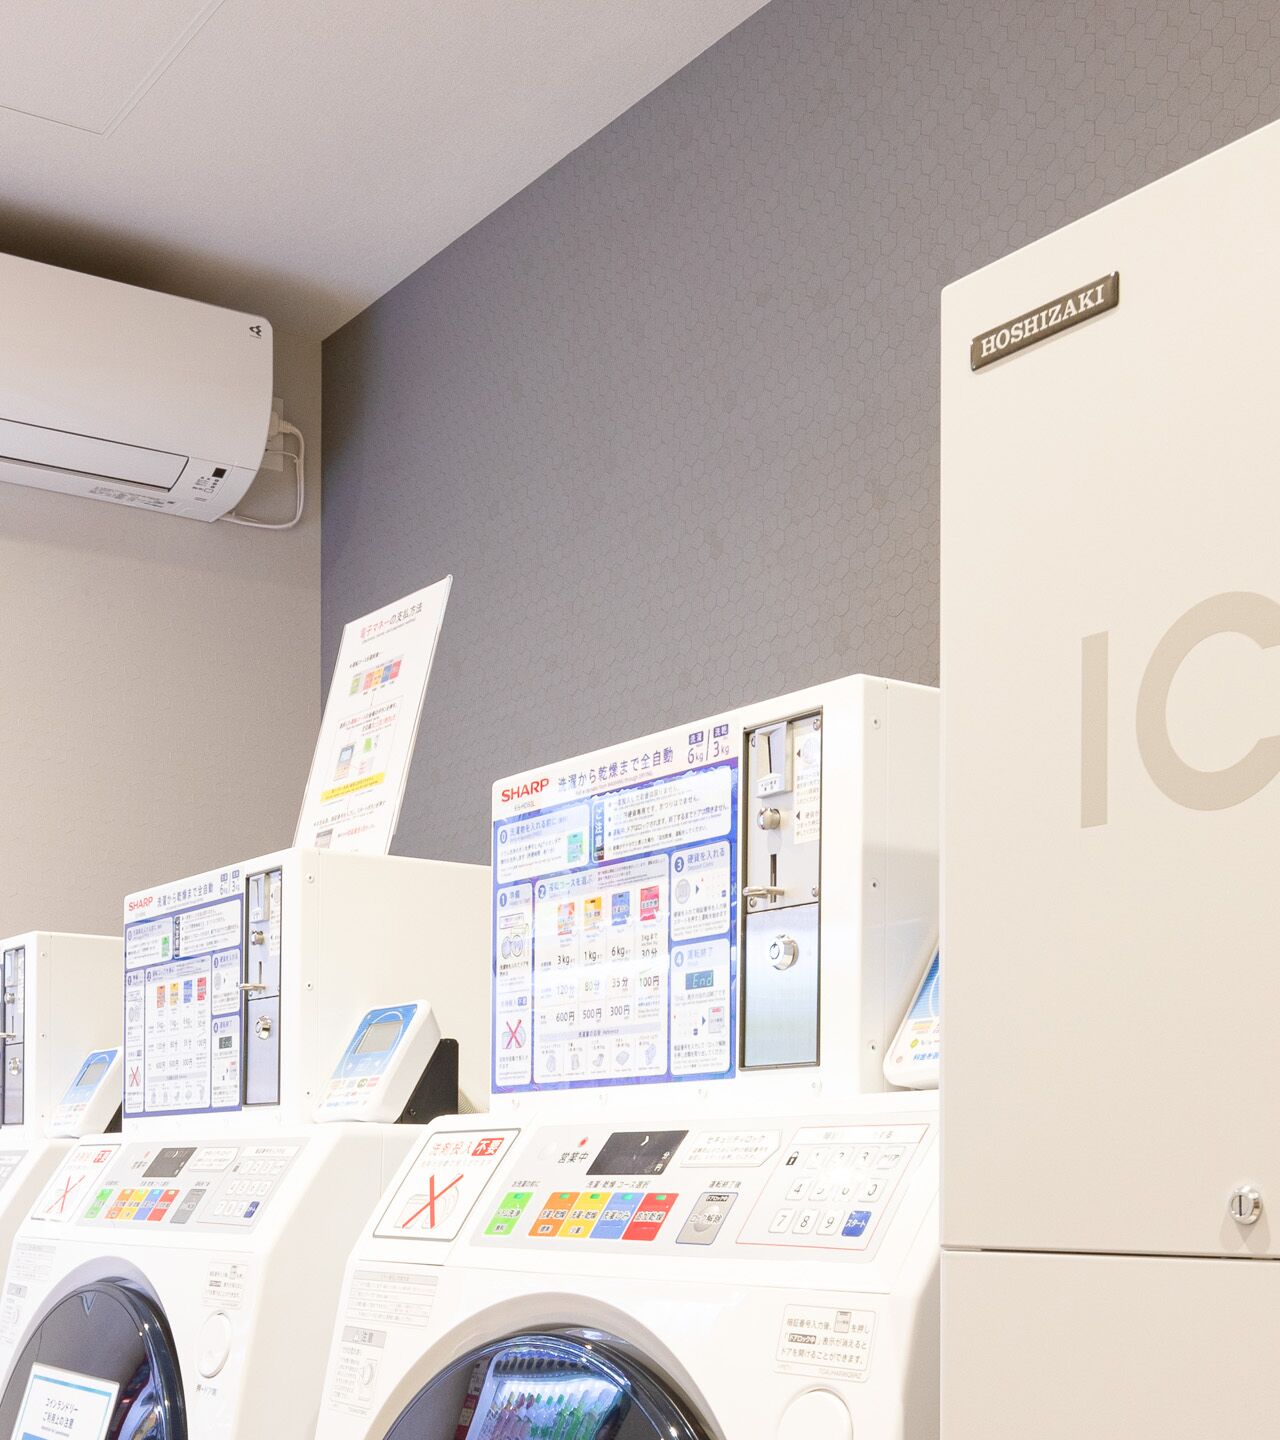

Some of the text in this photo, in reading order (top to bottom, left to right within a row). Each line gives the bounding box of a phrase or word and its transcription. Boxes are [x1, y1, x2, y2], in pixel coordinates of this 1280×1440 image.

[980, 284, 1105, 357] HOSHIZAKI
[687, 739, 730, 765] 6kg 3kg
[501, 778, 549, 802] SHARP
[687, 847, 725, 864] 硬貨を入れる
[128, 896, 153, 911] SHARP
[557, 954, 570, 965] 3kg
[584, 951, 597, 961] 1kg
[611, 946, 625, 957] 6kg
[692, 972, 713, 987] End
[555, 1005, 630, 1022] 600円 500円 300円
[475, 1138, 503, 1157] 不要
[558, 1152, 590, 1165] 営業中
[777, 1215, 866, 1229] 7 8 9 スタート
[45, 1398, 78, 1413] コインランドリー
